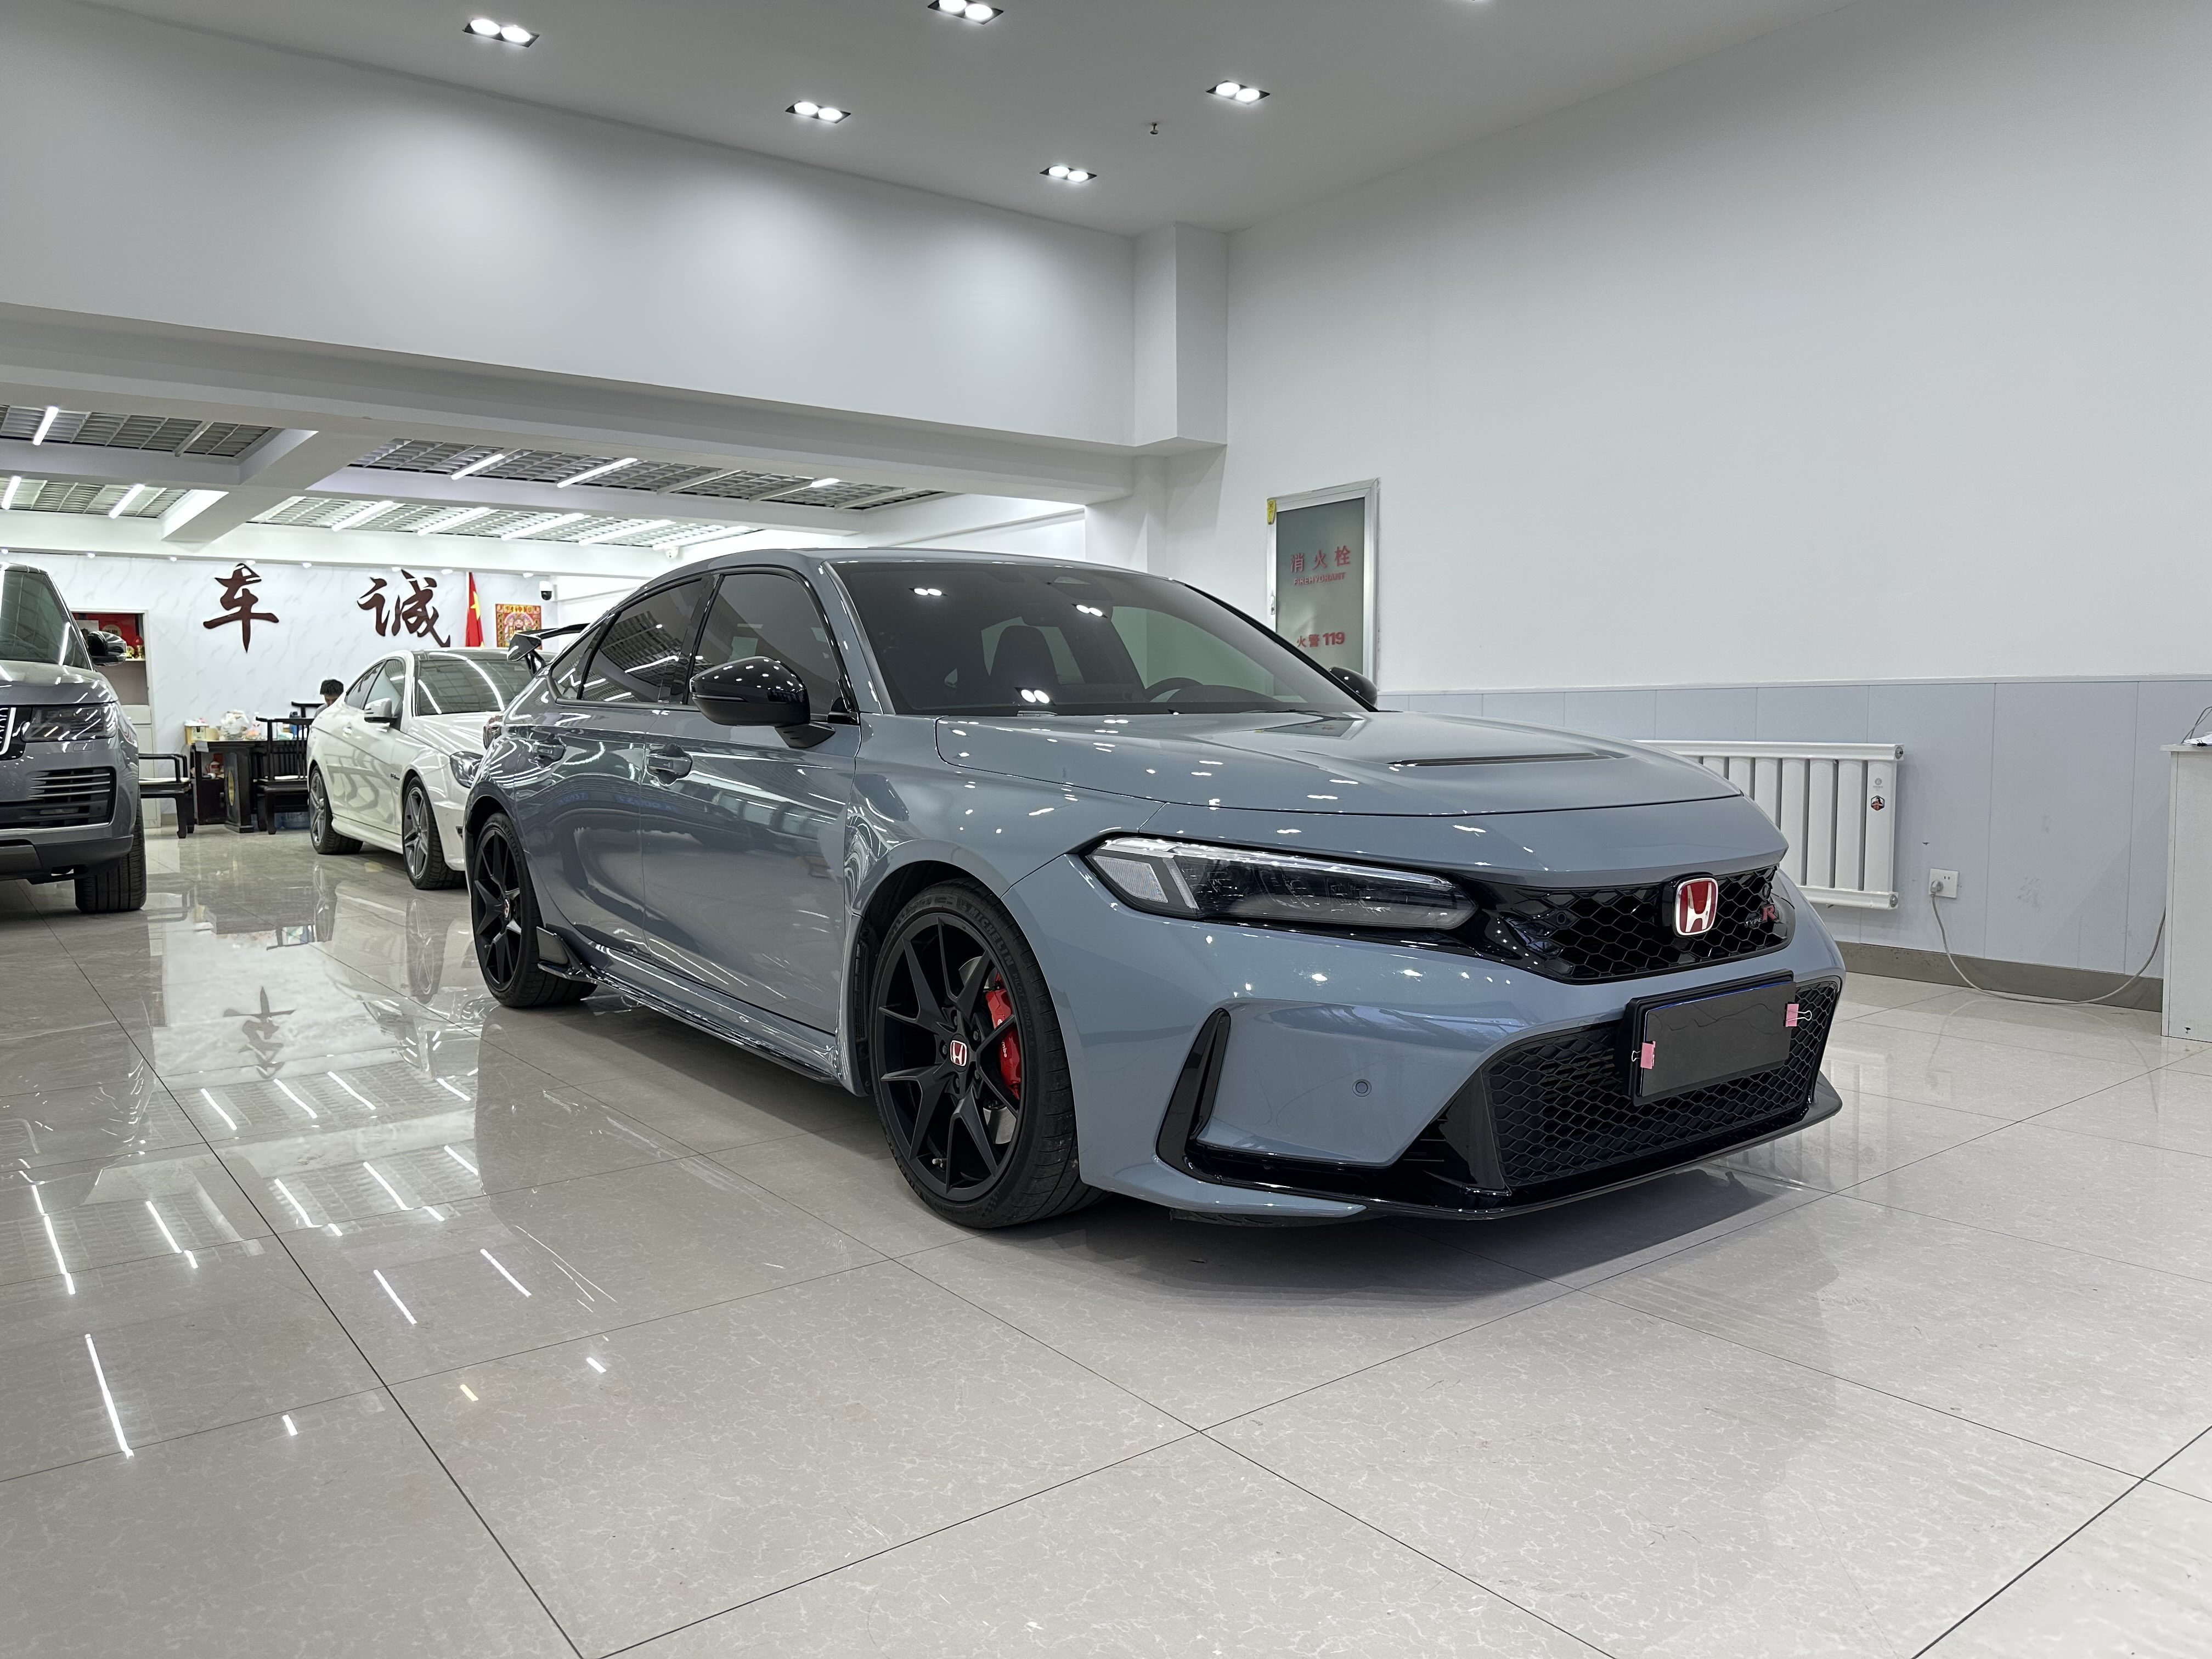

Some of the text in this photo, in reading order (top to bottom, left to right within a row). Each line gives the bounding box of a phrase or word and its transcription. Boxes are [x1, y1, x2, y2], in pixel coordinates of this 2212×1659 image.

[1290, 545, 1350, 573] 消火栓
[1293, 572, 1345, 585] FIREHYDRANT
[1296, 631, 1345, 647] 火警 119
[1762, 904, 1778, 921] R
[968, 906, 1014, 966] MICHELIN
[1012, 973, 1025, 997] PILOT
[1022, 1001, 1033, 1032] SPORT
